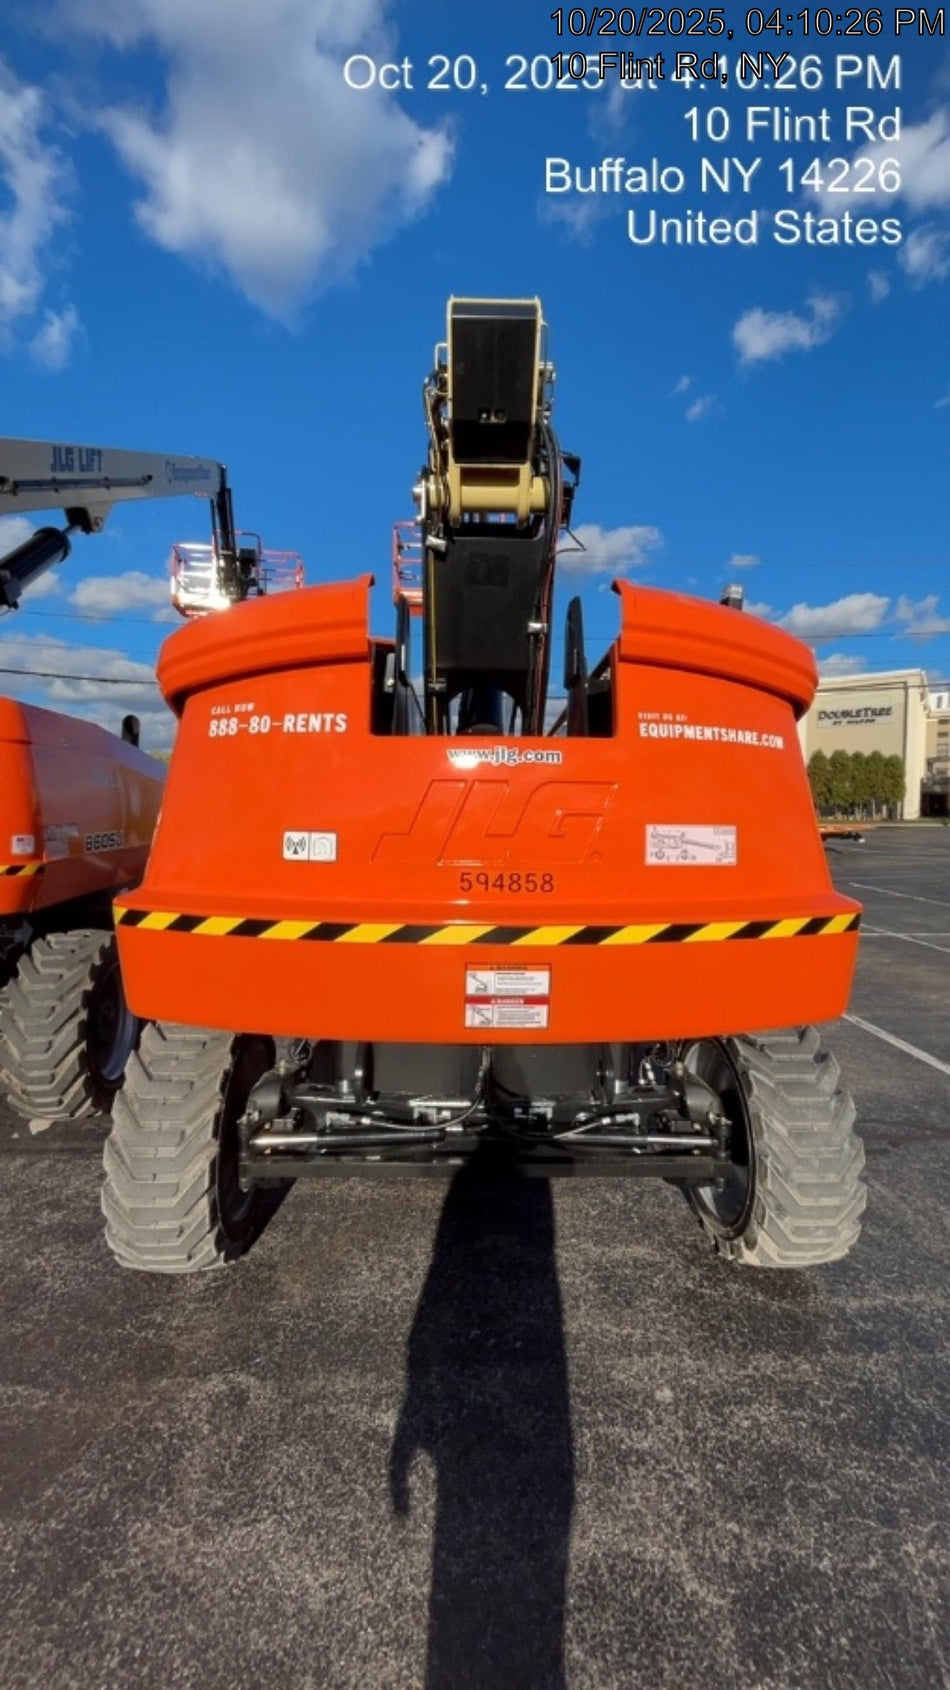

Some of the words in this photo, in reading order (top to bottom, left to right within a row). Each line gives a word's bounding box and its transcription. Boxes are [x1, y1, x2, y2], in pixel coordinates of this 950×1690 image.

[51, 446, 74, 473] JLG
[77, 447, 103, 474] LIFT
[208, 713, 348, 738] 888-80-RENTS
[639, 722, 784, 749] EQUIPMENTSHARE.COM
[447, 745, 562, 766] www.jlg.com
[459, 872, 555, 893] 594858
